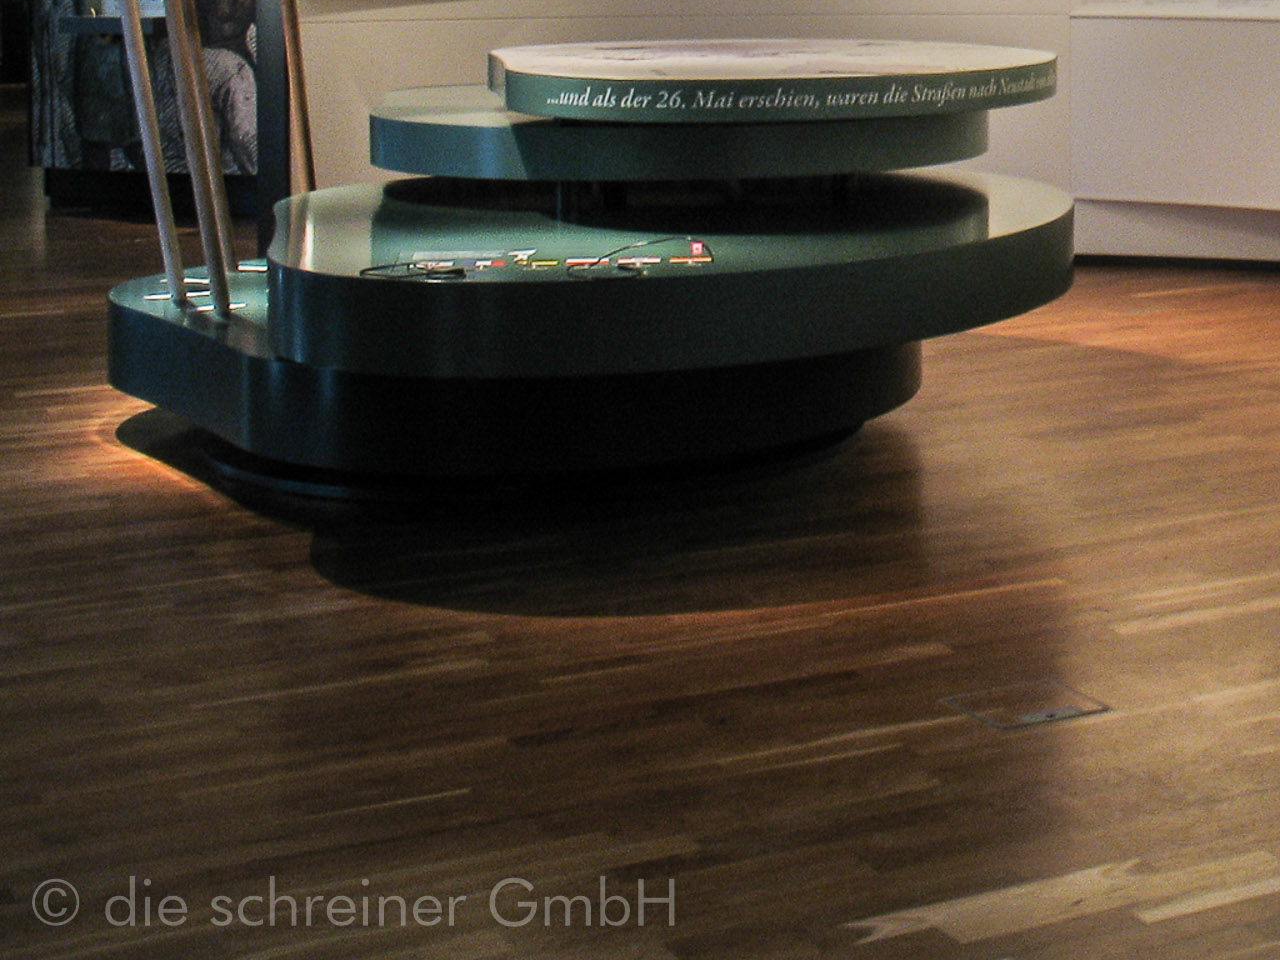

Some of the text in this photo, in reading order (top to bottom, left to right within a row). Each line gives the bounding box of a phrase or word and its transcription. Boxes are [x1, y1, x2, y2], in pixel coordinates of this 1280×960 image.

[592, 86, 617, 108] als
[620, 87, 652, 109] der
[656, 90, 686, 110] 26.
[692, 90, 734, 110] Mai
[738, 87, 820, 111] erschien,
[826, 91, 880, 107] waren
[883, 83, 907, 105] die
[911, 82, 966, 107] Straßen
[969, 77, 997, 99] nach
